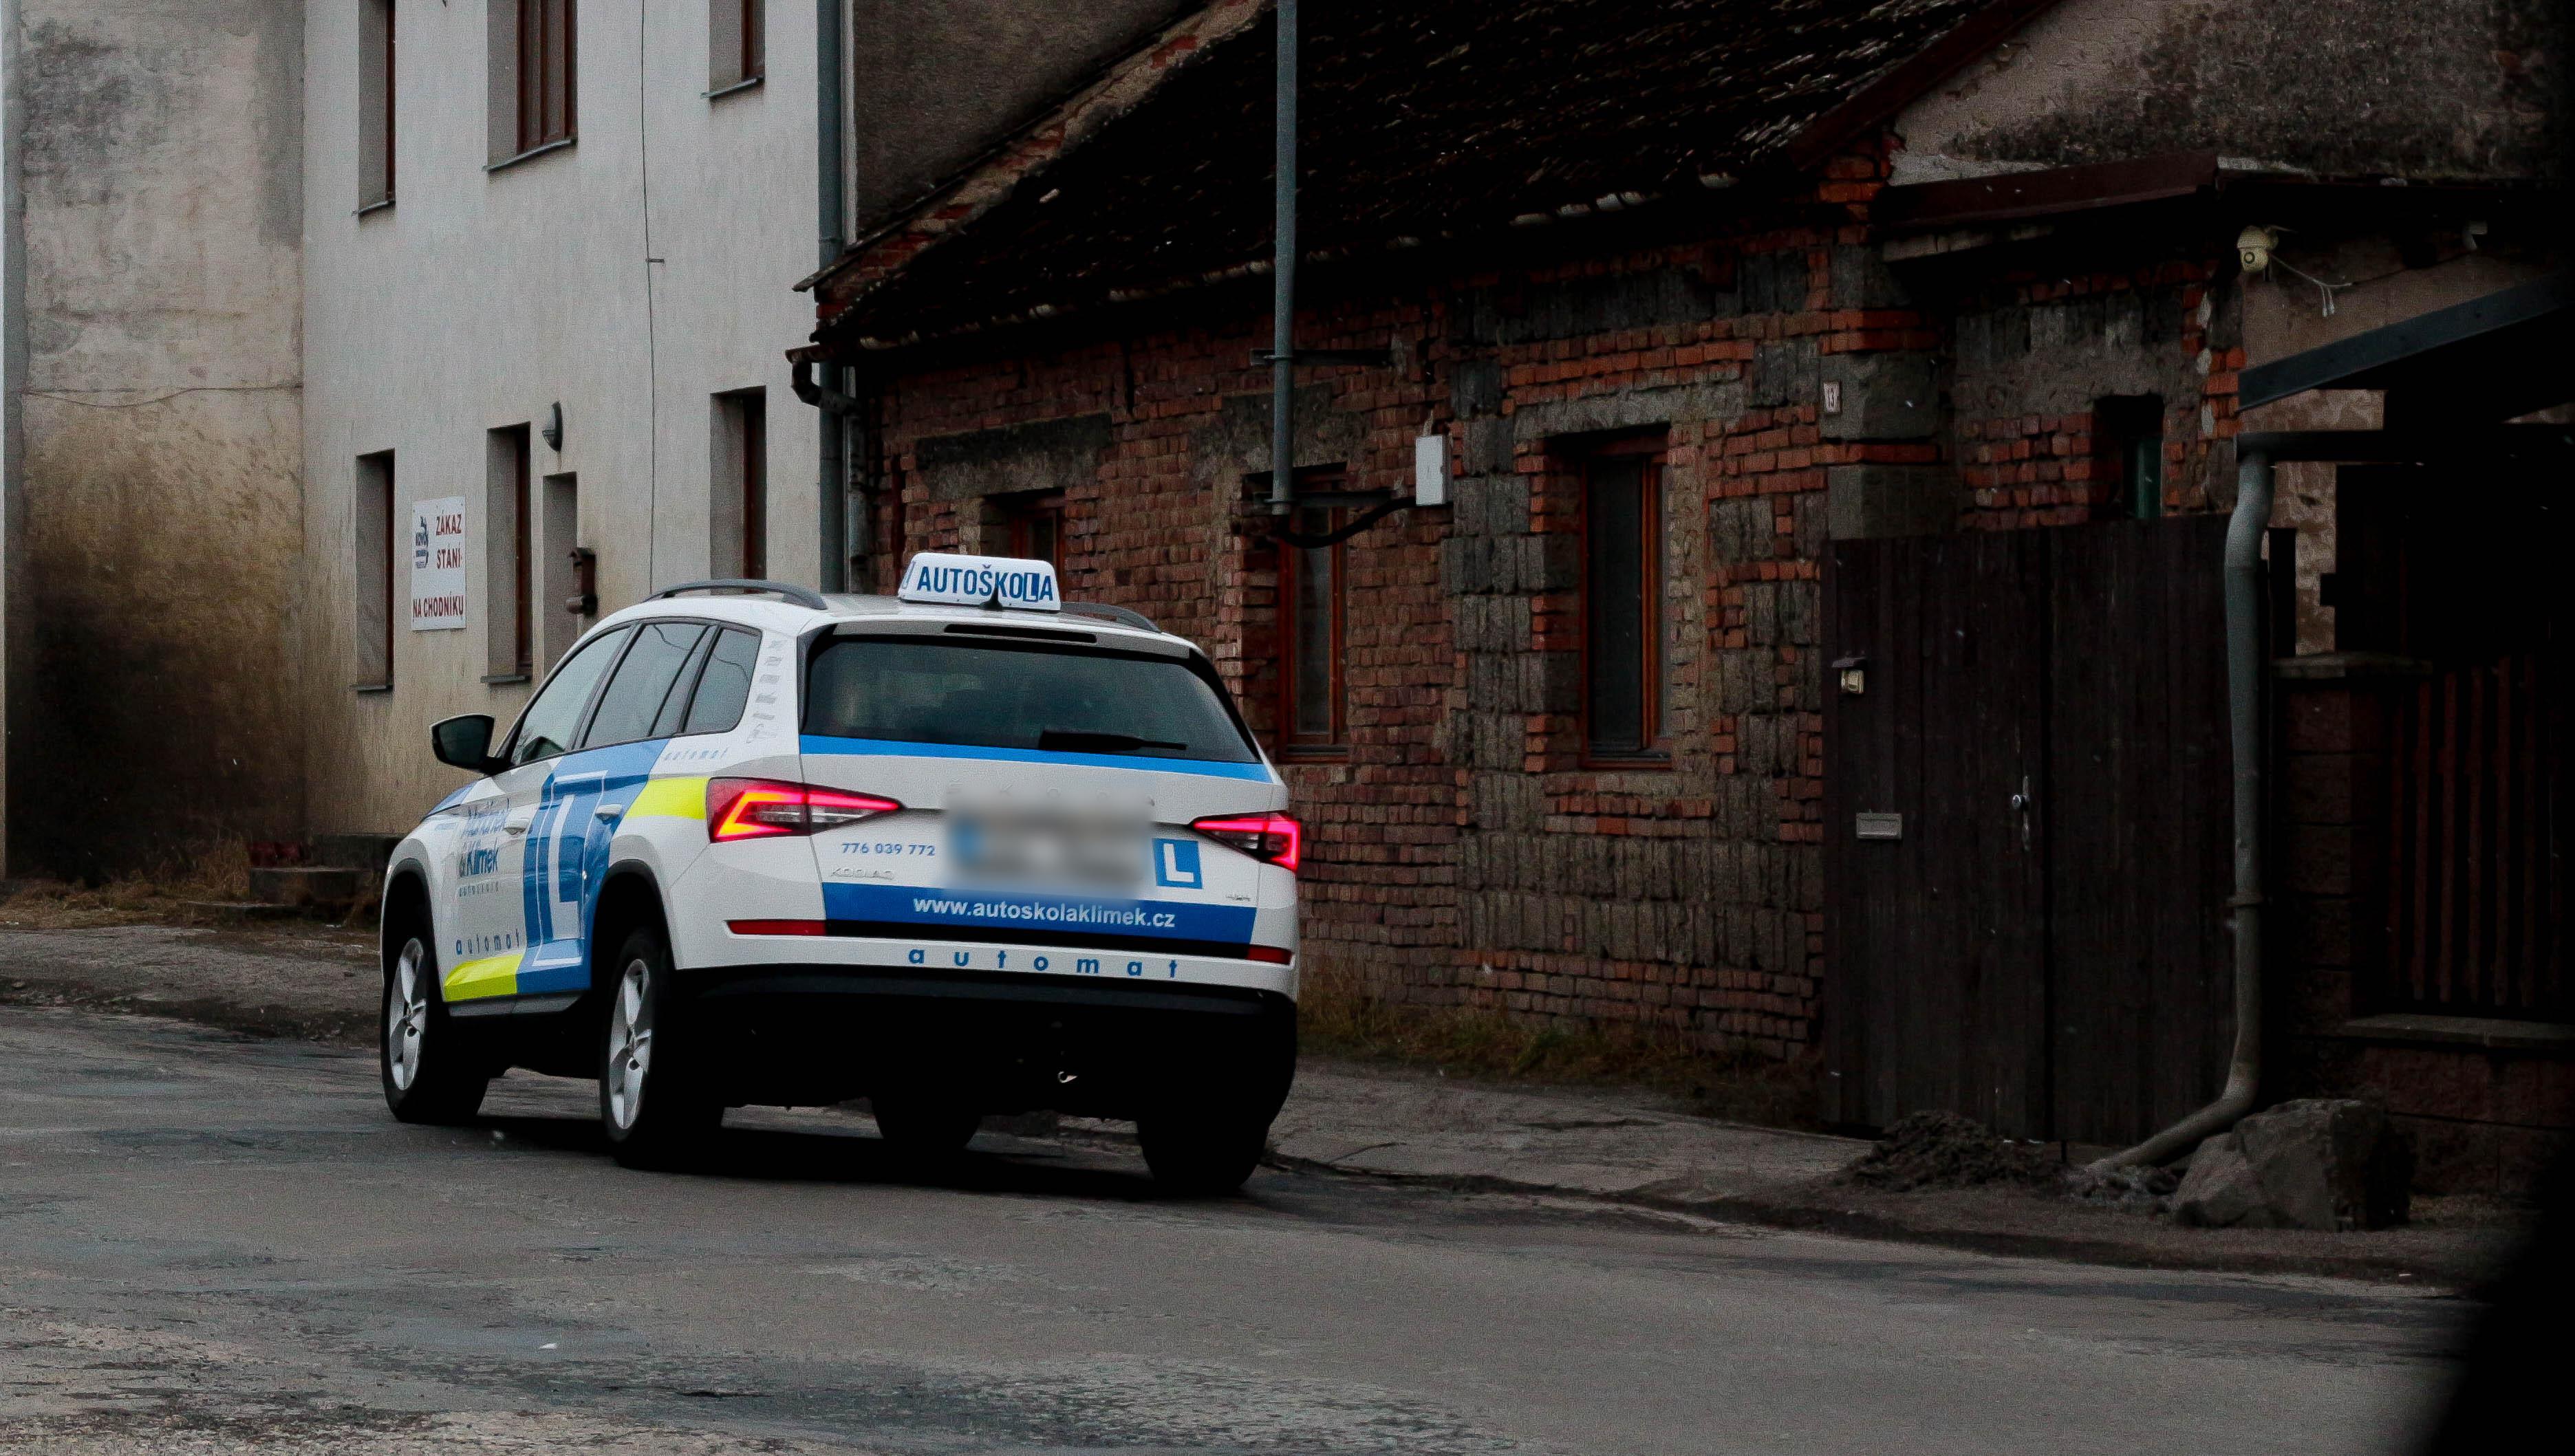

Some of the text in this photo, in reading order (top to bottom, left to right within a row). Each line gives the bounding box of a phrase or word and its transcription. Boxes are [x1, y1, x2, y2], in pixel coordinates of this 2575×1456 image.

[435, 510, 462, 536] ZÁKAZ
[436, 543, 461, 569] STÁNÍ
[916, 563, 1054, 602] AUTOŠKOLA
[413, 591, 464, 618] NA CHODNÍKU
[842, 843, 936, 856] 776 039 772
[1163, 843, 1195, 882] L
[913, 898, 1176, 928] www.autoskolaklimek.cz
[455, 928, 519, 955] automat
[908, 948, 1178, 978] automat
